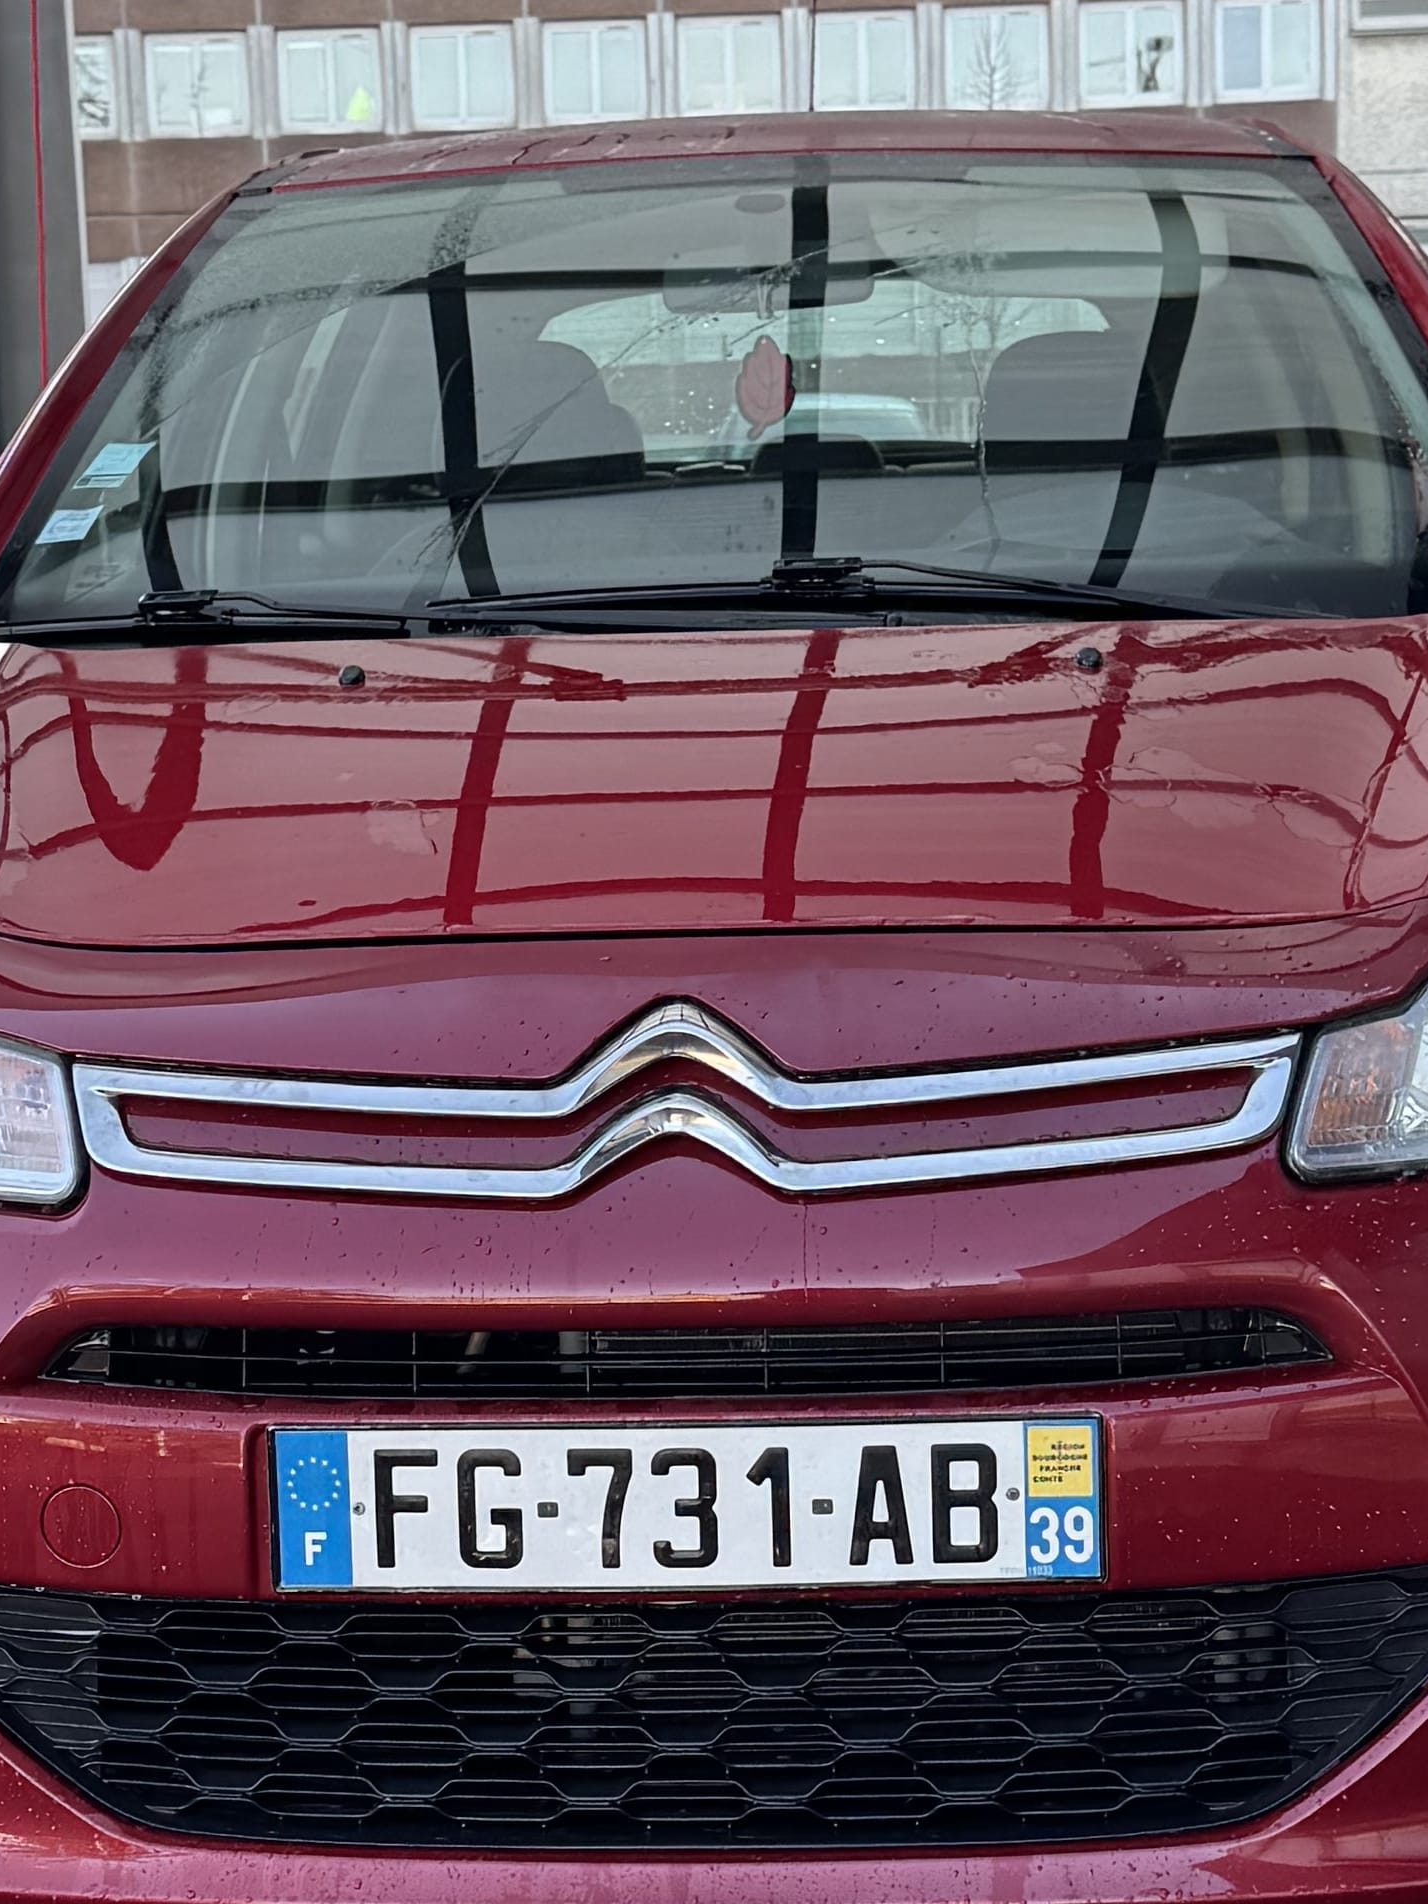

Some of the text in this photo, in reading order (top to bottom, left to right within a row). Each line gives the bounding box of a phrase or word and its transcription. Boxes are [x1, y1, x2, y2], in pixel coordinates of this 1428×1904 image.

[374, 1444, 998, 1569] FG-731-AB
[1030, 1506, 1093, 1563] 39
[304, 1532, 327, 1565] F
